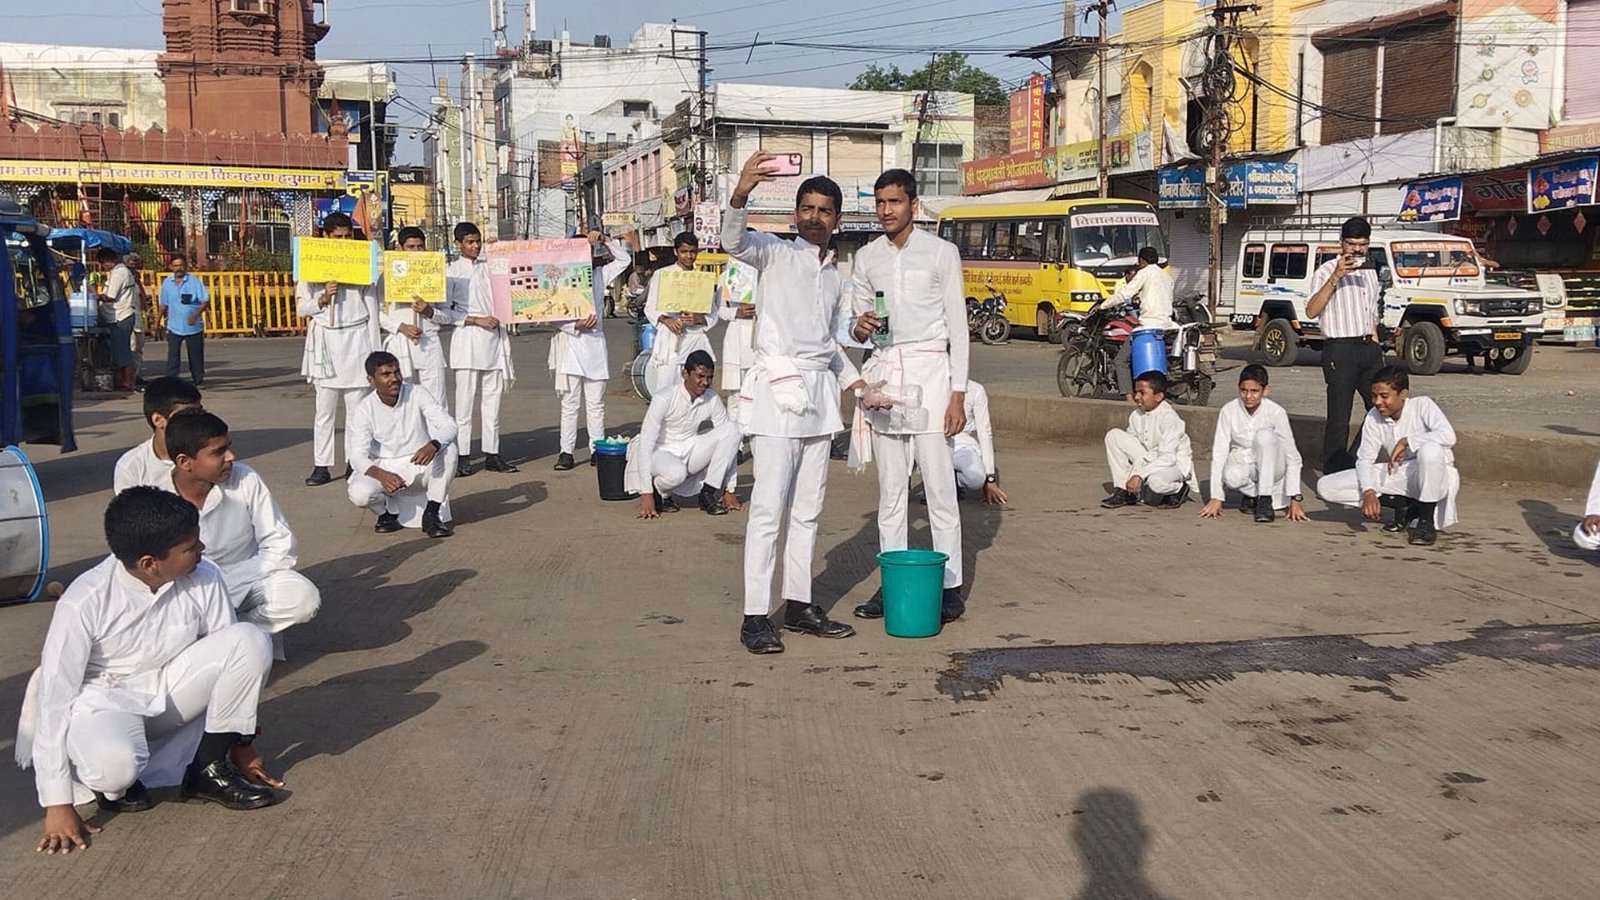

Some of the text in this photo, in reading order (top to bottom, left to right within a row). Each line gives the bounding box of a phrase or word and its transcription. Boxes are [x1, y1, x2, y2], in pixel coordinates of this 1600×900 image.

[20, 166, 43, 176] जय
[48, 167, 71, 177] राम
[104, 168, 126, 178] जय
[131, 168, 154, 178] राम
[159, 169, 181, 179] जय
[187, 170, 208, 180] जय
[212, 168, 274, 183] विघ्नहरण
[278, 174, 321, 187] हनुमान
[1232, 314, 1254, 324] 2020
